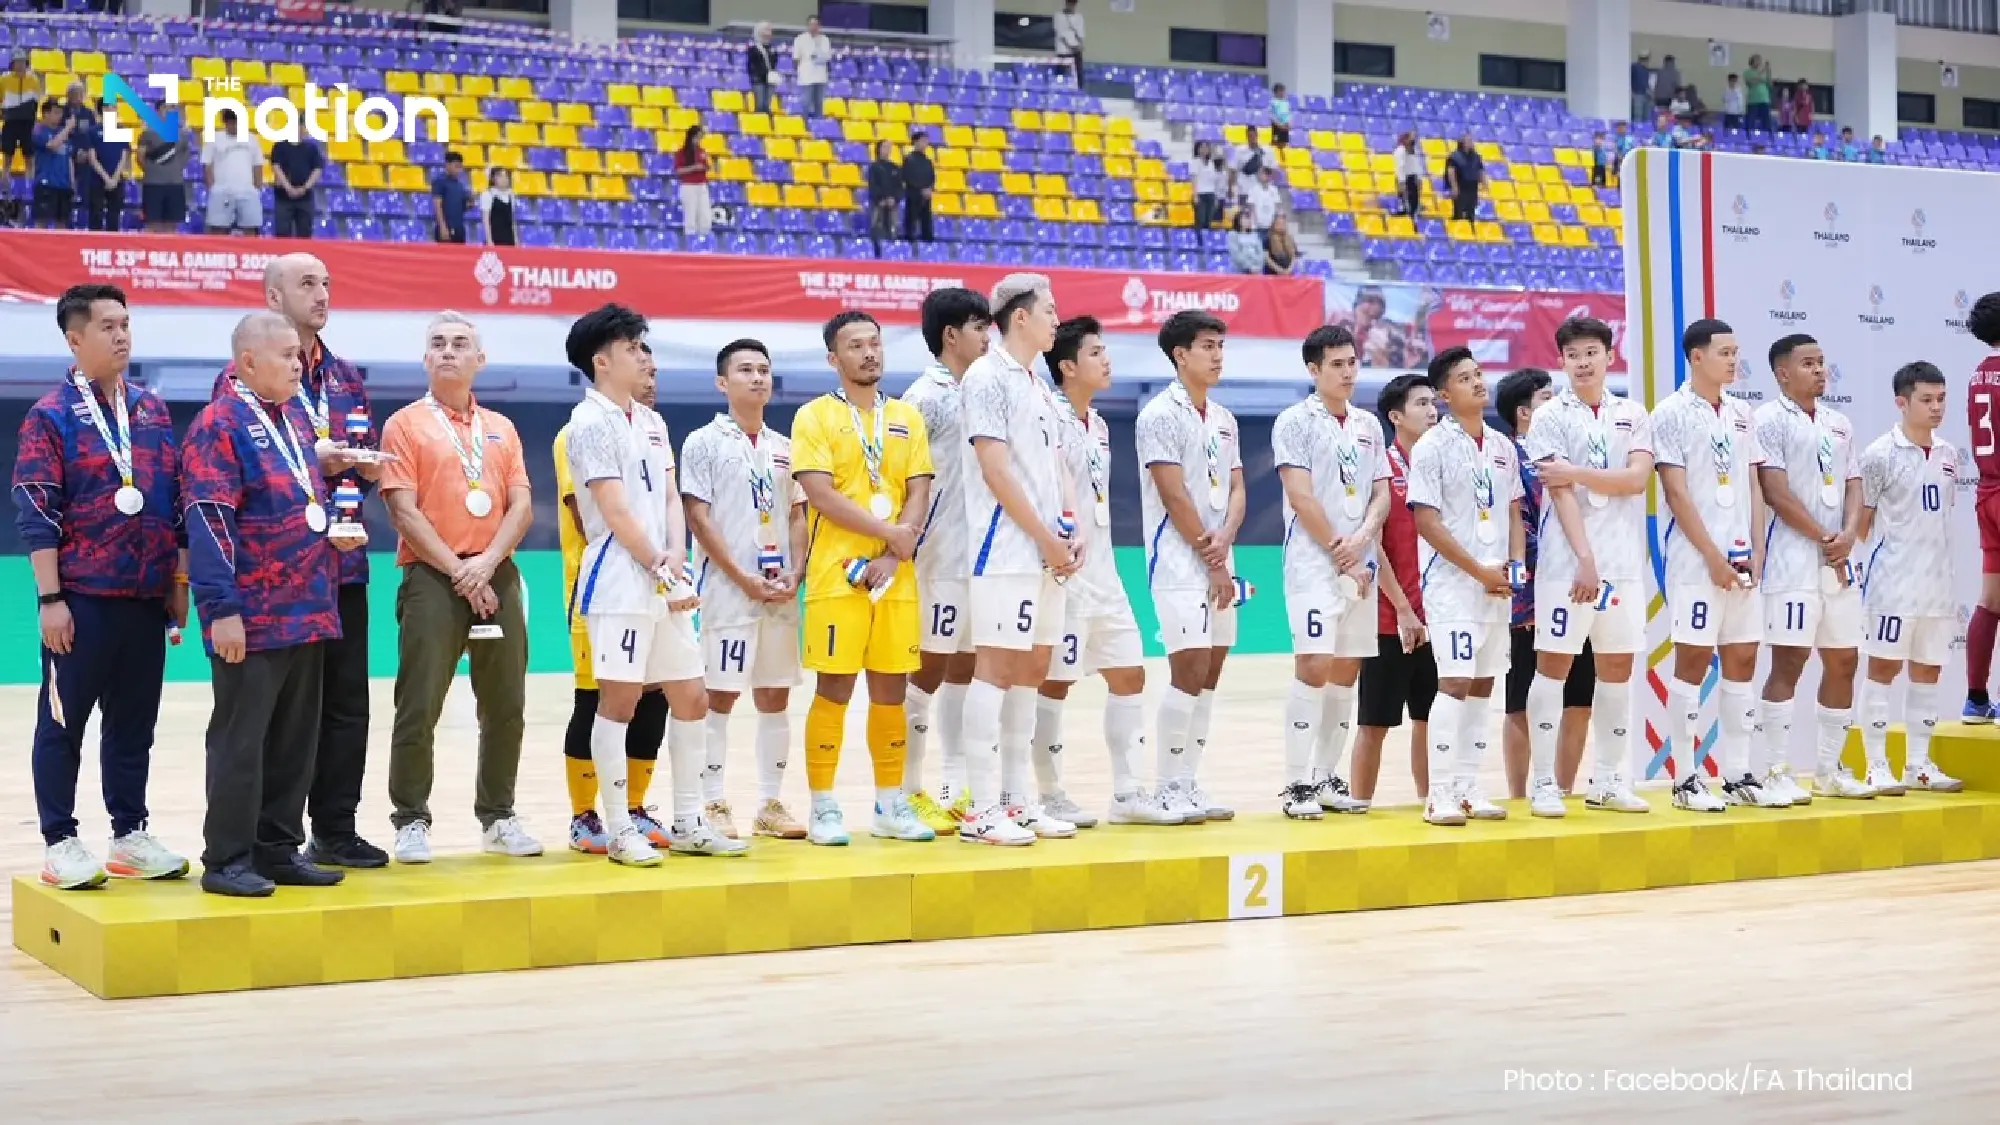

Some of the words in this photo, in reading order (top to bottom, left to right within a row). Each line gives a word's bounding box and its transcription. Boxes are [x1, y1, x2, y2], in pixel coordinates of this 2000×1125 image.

[1722, 224, 1760, 236] THAILAND
[1814, 231, 1850, 243] THAILAND
[1902, 238, 1936, 248] THAILAND
[80, 248, 112, 266] THE
[241, 254, 274, 269] 202
[508, 266, 618, 289] THAILAND
[1150, 289, 1240, 311] THAILAND
[1769, 310, 1807, 321] THAILAND
[1858, 314, 1895, 325] THAILAND
[1975, 394, 1995, 456] 3
[1922, 484, 1940, 511] 10
[931, 603, 957, 636] 12
[1017, 600, 1033, 632] 5
[1307, 609, 1323, 638] 6
[1551, 608, 1567, 637] 9
[1691, 601, 1708, 630] 8
[1785, 602, 1804, 630] 11
[1878, 615, 1902, 643] 10
[621, 628, 636, 663] 4
[827, 625, 835, 657] 1
[1063, 634, 1078, 665] 3
[1450, 631, 1473, 660] 13
[720, 639, 746, 673] 14
[1244, 862, 1268, 907] 2
